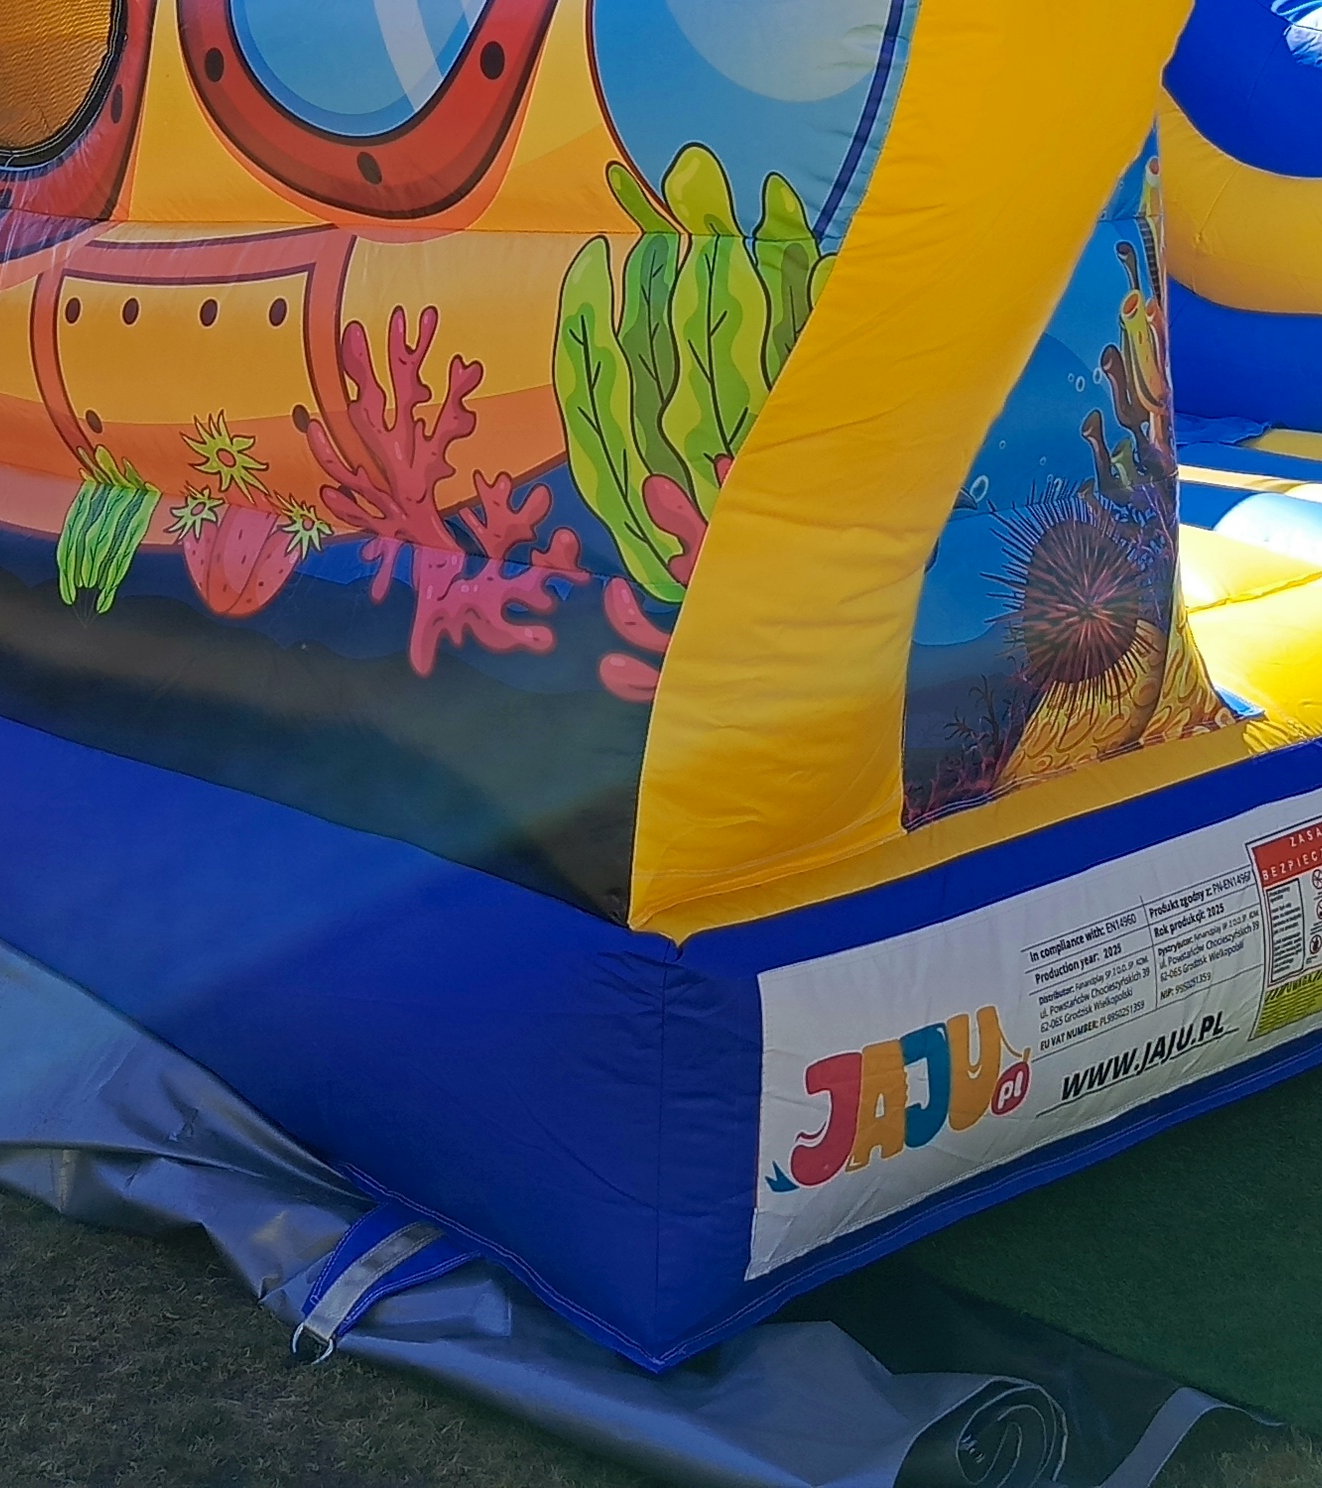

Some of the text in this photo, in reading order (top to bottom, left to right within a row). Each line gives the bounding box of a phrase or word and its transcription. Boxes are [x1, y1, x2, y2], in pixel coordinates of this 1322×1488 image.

[1153, 923, 1169, 938] Rok
[1207, 902, 1225, 918] 2025
[1029, 951, 1039, 962] In
[1040, 935, 1084, 959] compliance
[1034, 960, 1079, 984] Production
[1102, 942, 1122, 959] 2025
[1040, 1039, 1050, 1051] EU
[1050, 1032, 1066, 1046] VAT
[1060, 1011, 1225, 1101] WWW.JAJU.PL
[789, 1005, 1001, 1187] JAJU
